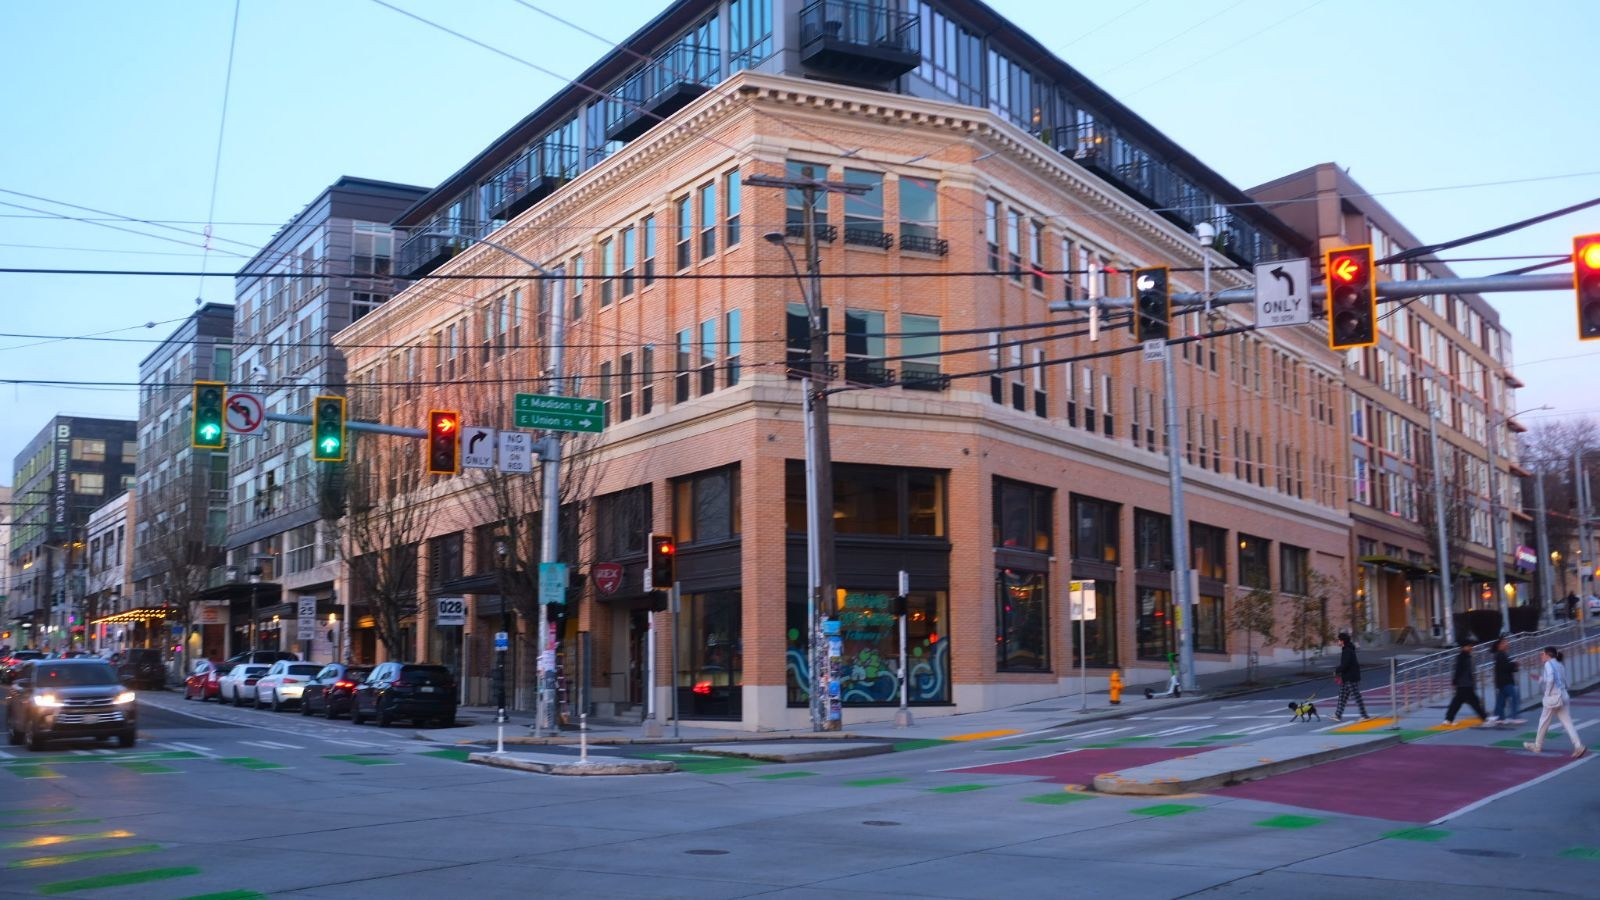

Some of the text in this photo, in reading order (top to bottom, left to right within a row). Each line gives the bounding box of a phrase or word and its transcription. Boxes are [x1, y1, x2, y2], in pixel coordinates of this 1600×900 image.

[1263, 298, 1302, 314] ONLY
[521, 397, 582, 411] E Madison St
[521, 415, 573, 427] E Union St
[58, 425, 70, 438] B
[507, 434, 523, 443] NO
[465, 455, 490, 466] ONLY
[510, 453, 521, 461] ON
[507, 462, 523, 470] RED
[300, 606, 315, 616] 25
